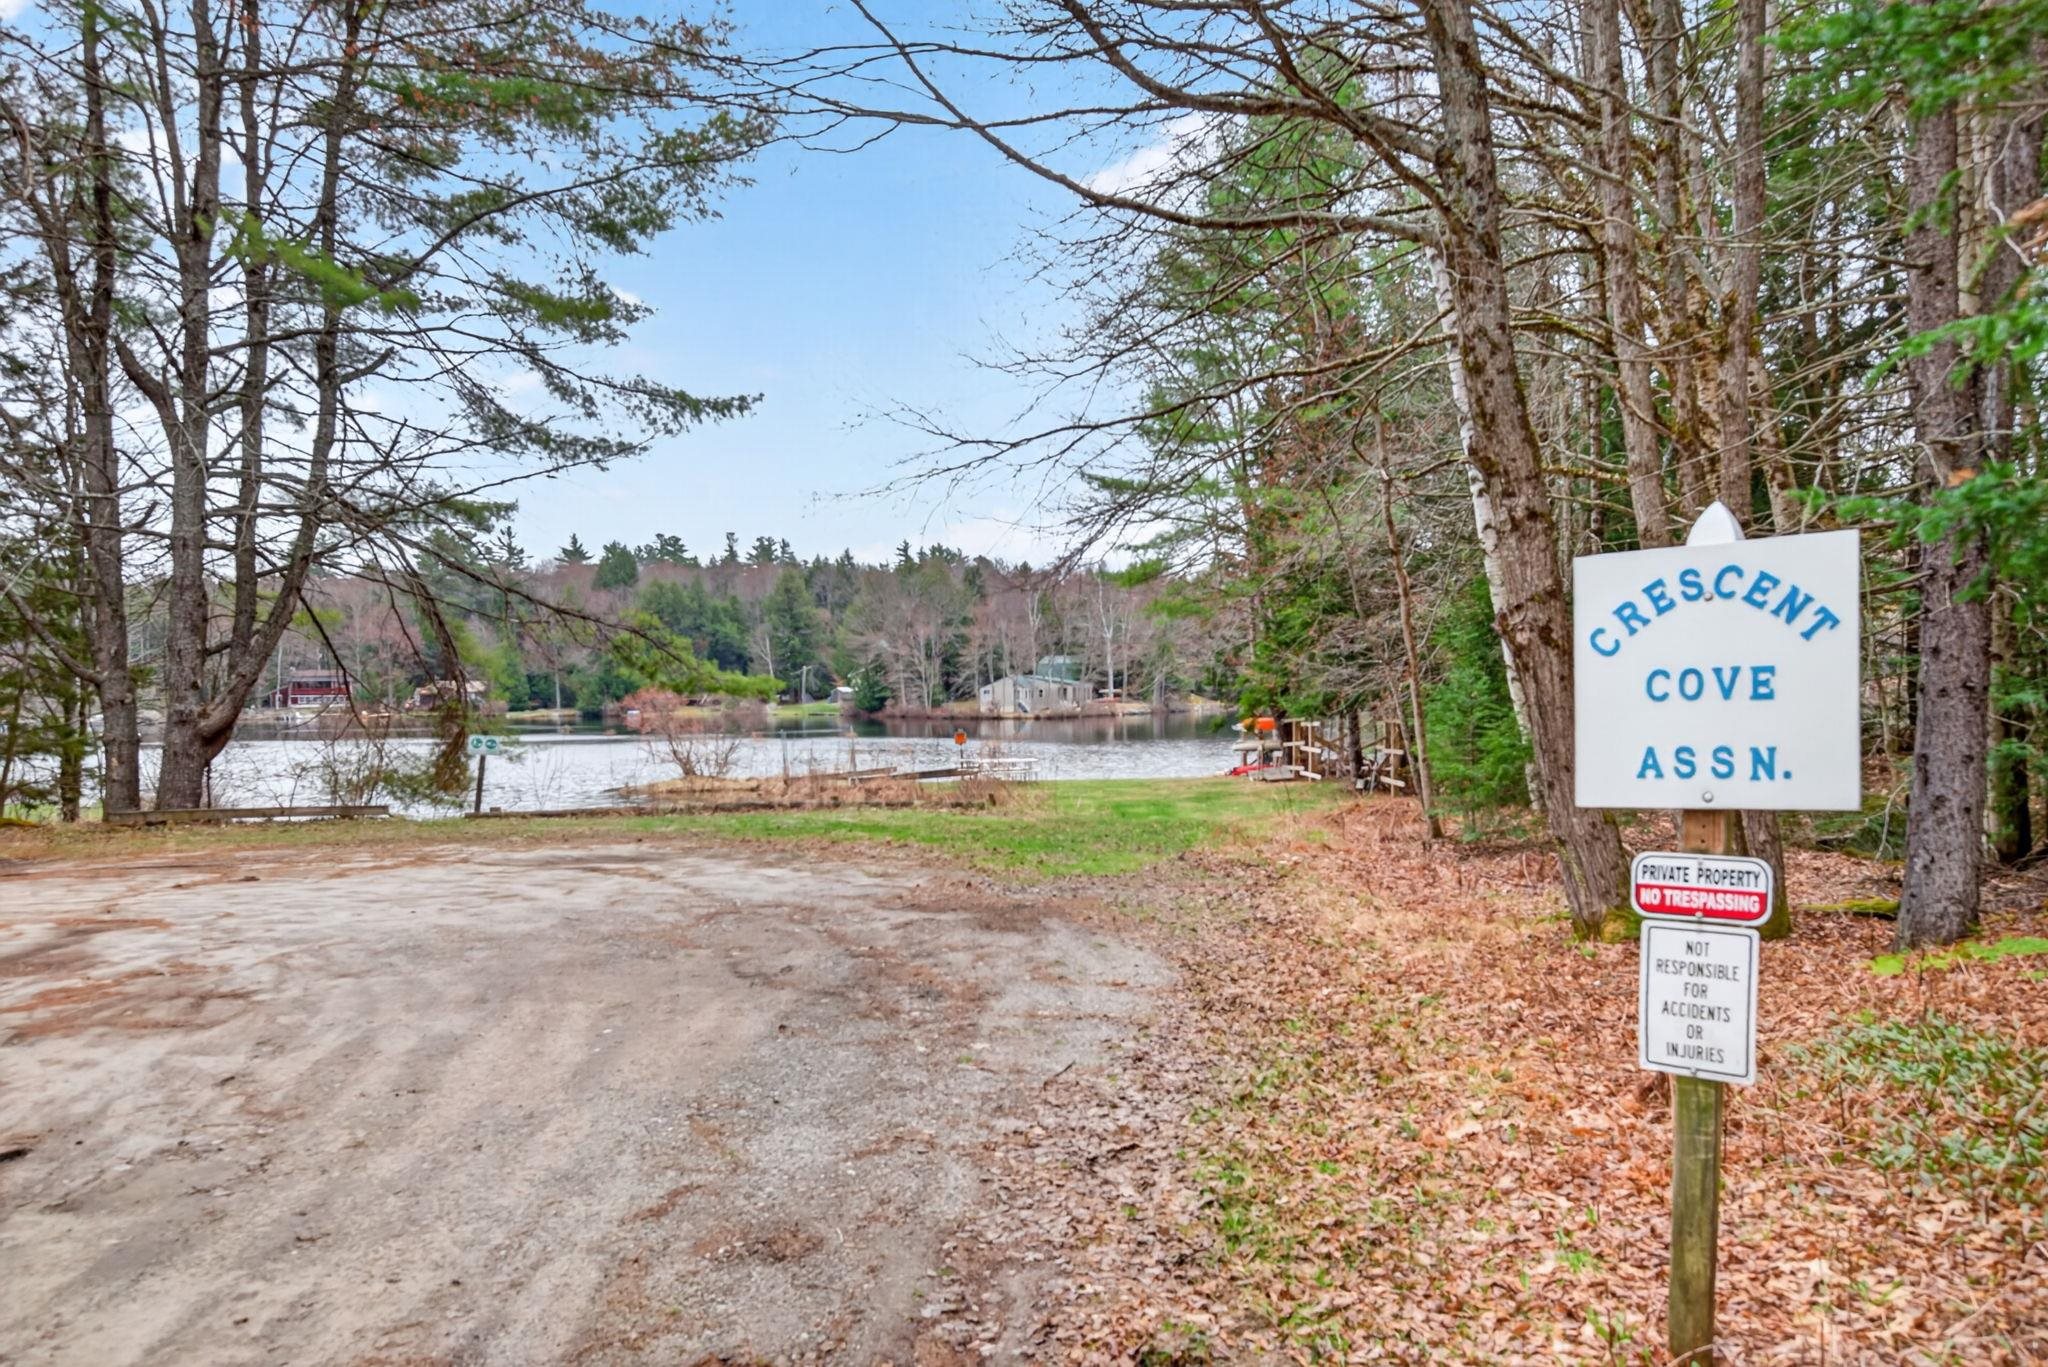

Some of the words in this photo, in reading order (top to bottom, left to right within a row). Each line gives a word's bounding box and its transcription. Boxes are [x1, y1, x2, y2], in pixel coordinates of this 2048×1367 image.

[1590, 565, 1840, 657] CRESCENT
[1646, 665, 1776, 702] COVE
[1636, 745, 1792, 781] ASSN.
[1642, 864, 1690, 883] PRIVATE
[1697, 867, 1761, 888] PROPERTY
[1639, 887, 1662, 905] NO
[1663, 888, 1760, 913] TRESPASSING
[1685, 941, 1710, 957] NOT
[1656, 958, 1740, 982] RESPONSIBLE
[1683, 982, 1708, 998] FOR
[1661, 1001, 1731, 1023] ACCIDENTS
[1686, 1024, 1704, 1040] OR
[1666, 1041, 1725, 1064] INJURIES
